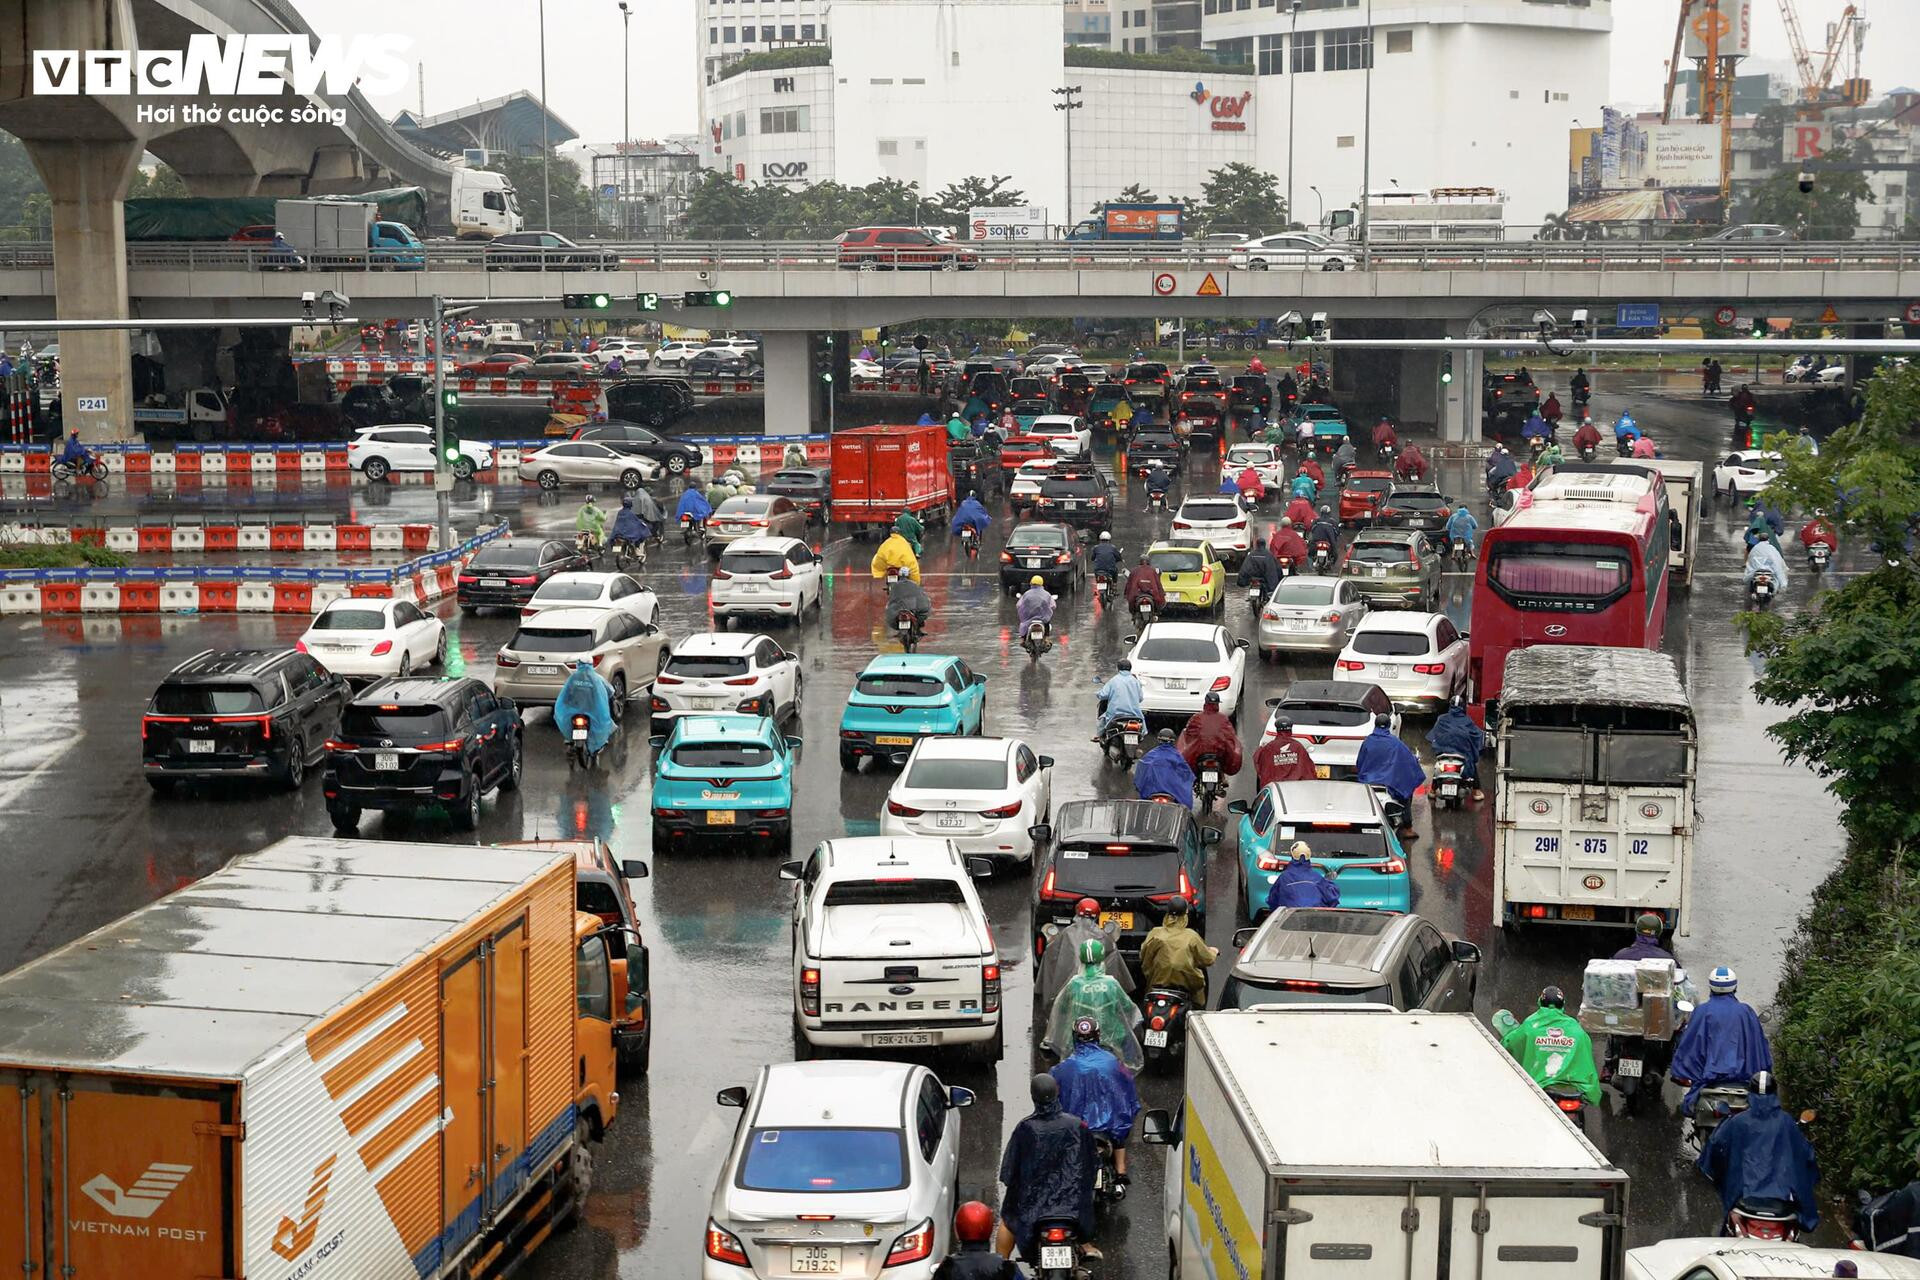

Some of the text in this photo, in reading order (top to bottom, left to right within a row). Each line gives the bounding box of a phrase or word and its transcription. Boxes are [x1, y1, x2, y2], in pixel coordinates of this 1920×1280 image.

[1211, 93, 1250, 118] CGV
[1794, 127, 1823, 158] R
[762, 162, 808, 178] LOOP
[643, 294, 657, 310] 12
[79, 399, 106, 410] P241
[1517, 599, 1595, 609] UNIVERSE
[1535, 837, 1558, 852] 29H
[1108, 912, 1123, 920] 29K
[1083, 982, 1108, 993] Grab
[825, 999, 978, 1012] RANGER
[877, 1034, 927, 1044] 29K-214.35
[69, 1220, 207, 1242] VIETNAM POST
[806, 1248, 828, 1259] 30G
